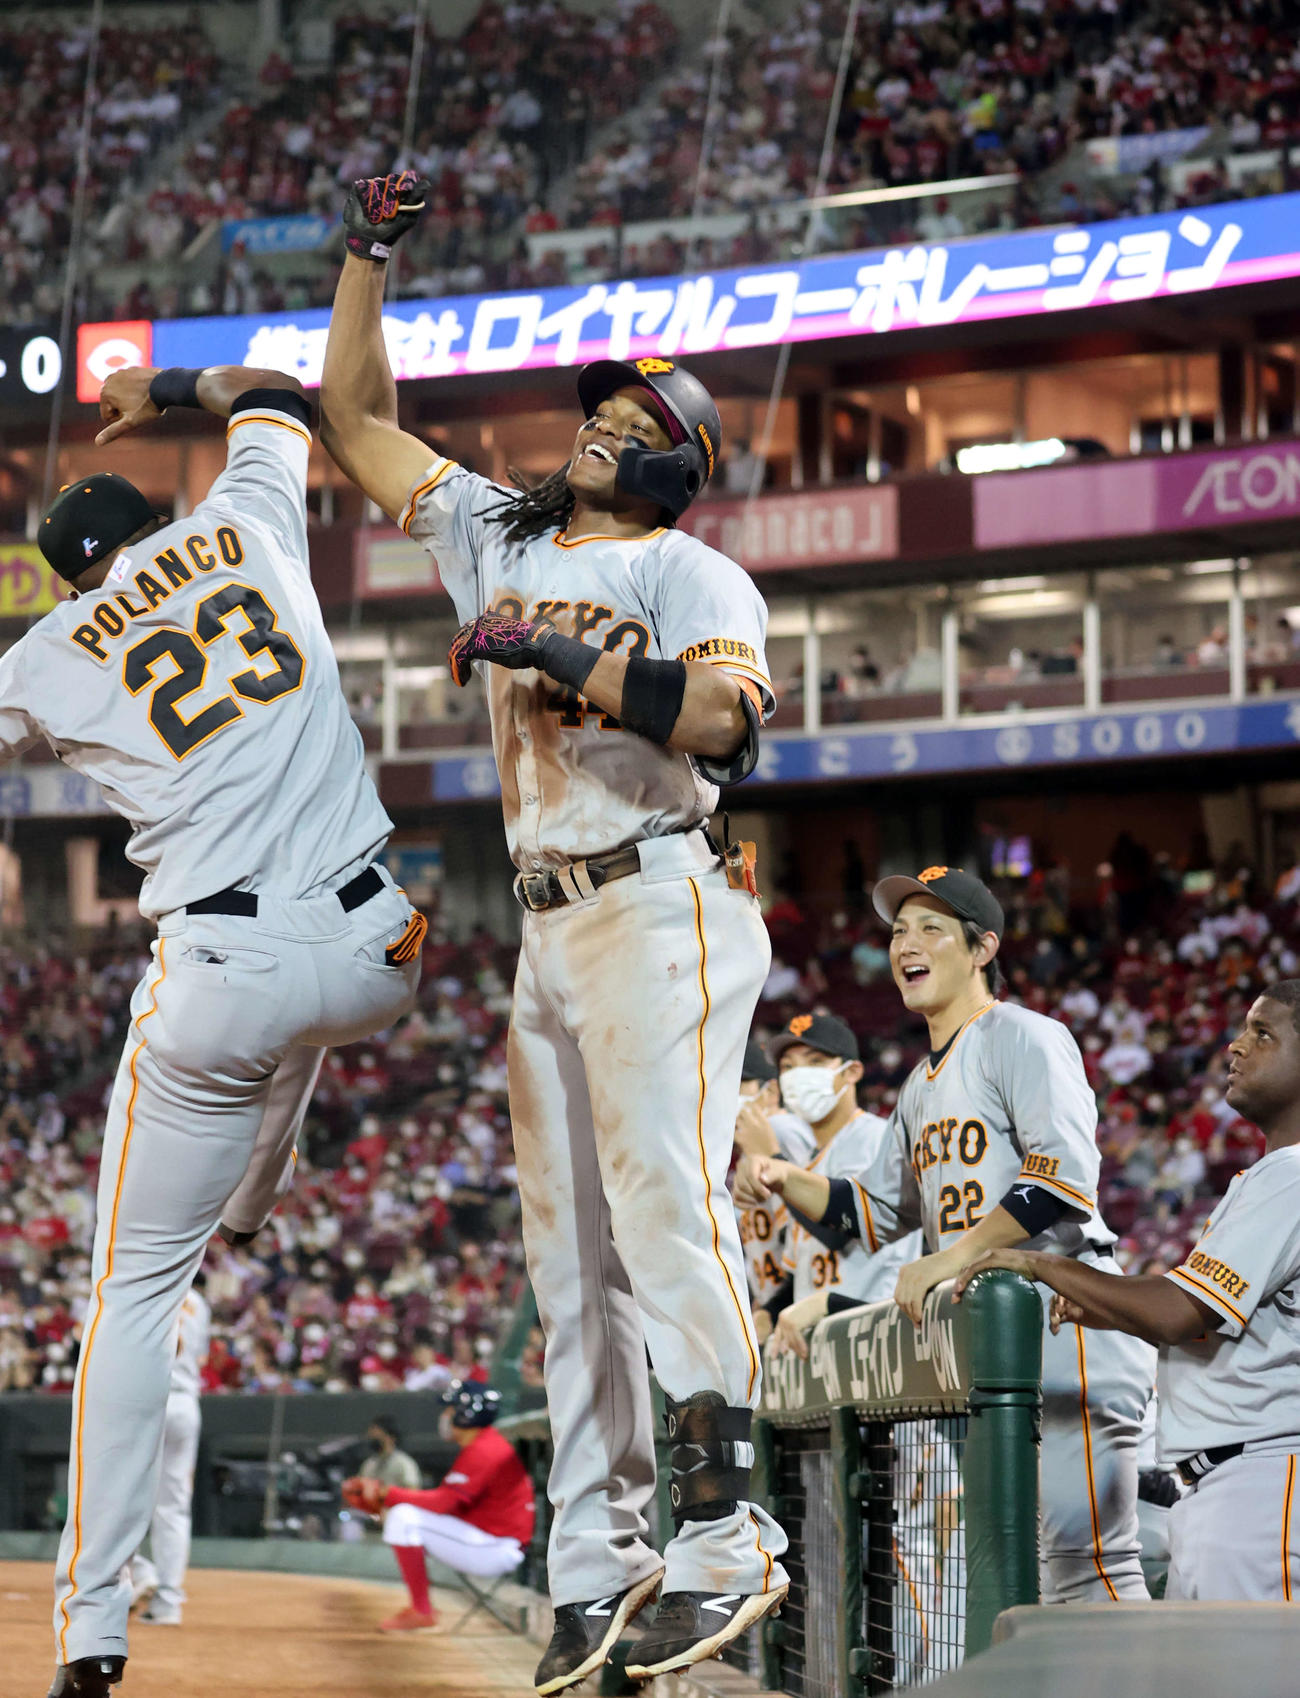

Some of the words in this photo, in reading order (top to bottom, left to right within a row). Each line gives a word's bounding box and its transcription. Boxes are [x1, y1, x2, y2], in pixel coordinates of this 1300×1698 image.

[21, 336, 62, 394] 0
[70, 526, 246, 663] POLANCO
[122, 581, 307, 762] 23
[939, 1180, 987, 1235] 22
